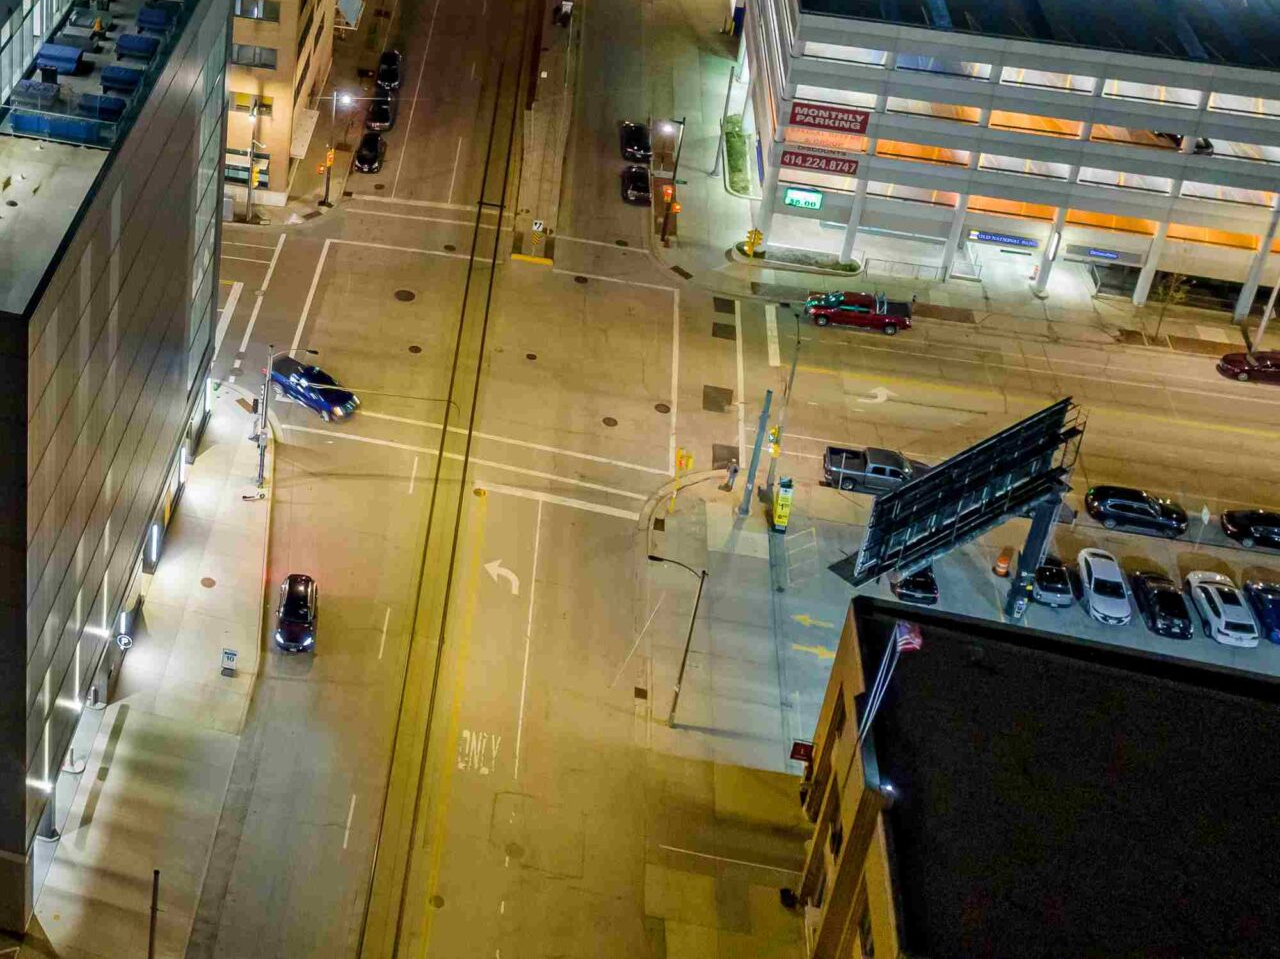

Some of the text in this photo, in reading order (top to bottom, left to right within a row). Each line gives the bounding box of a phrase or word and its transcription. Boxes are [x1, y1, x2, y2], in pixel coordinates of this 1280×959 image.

[794, 106, 865, 122] MONTHLY
[795, 114, 861, 130] PARKING
[783, 154, 856, 173] 414.224.8747
